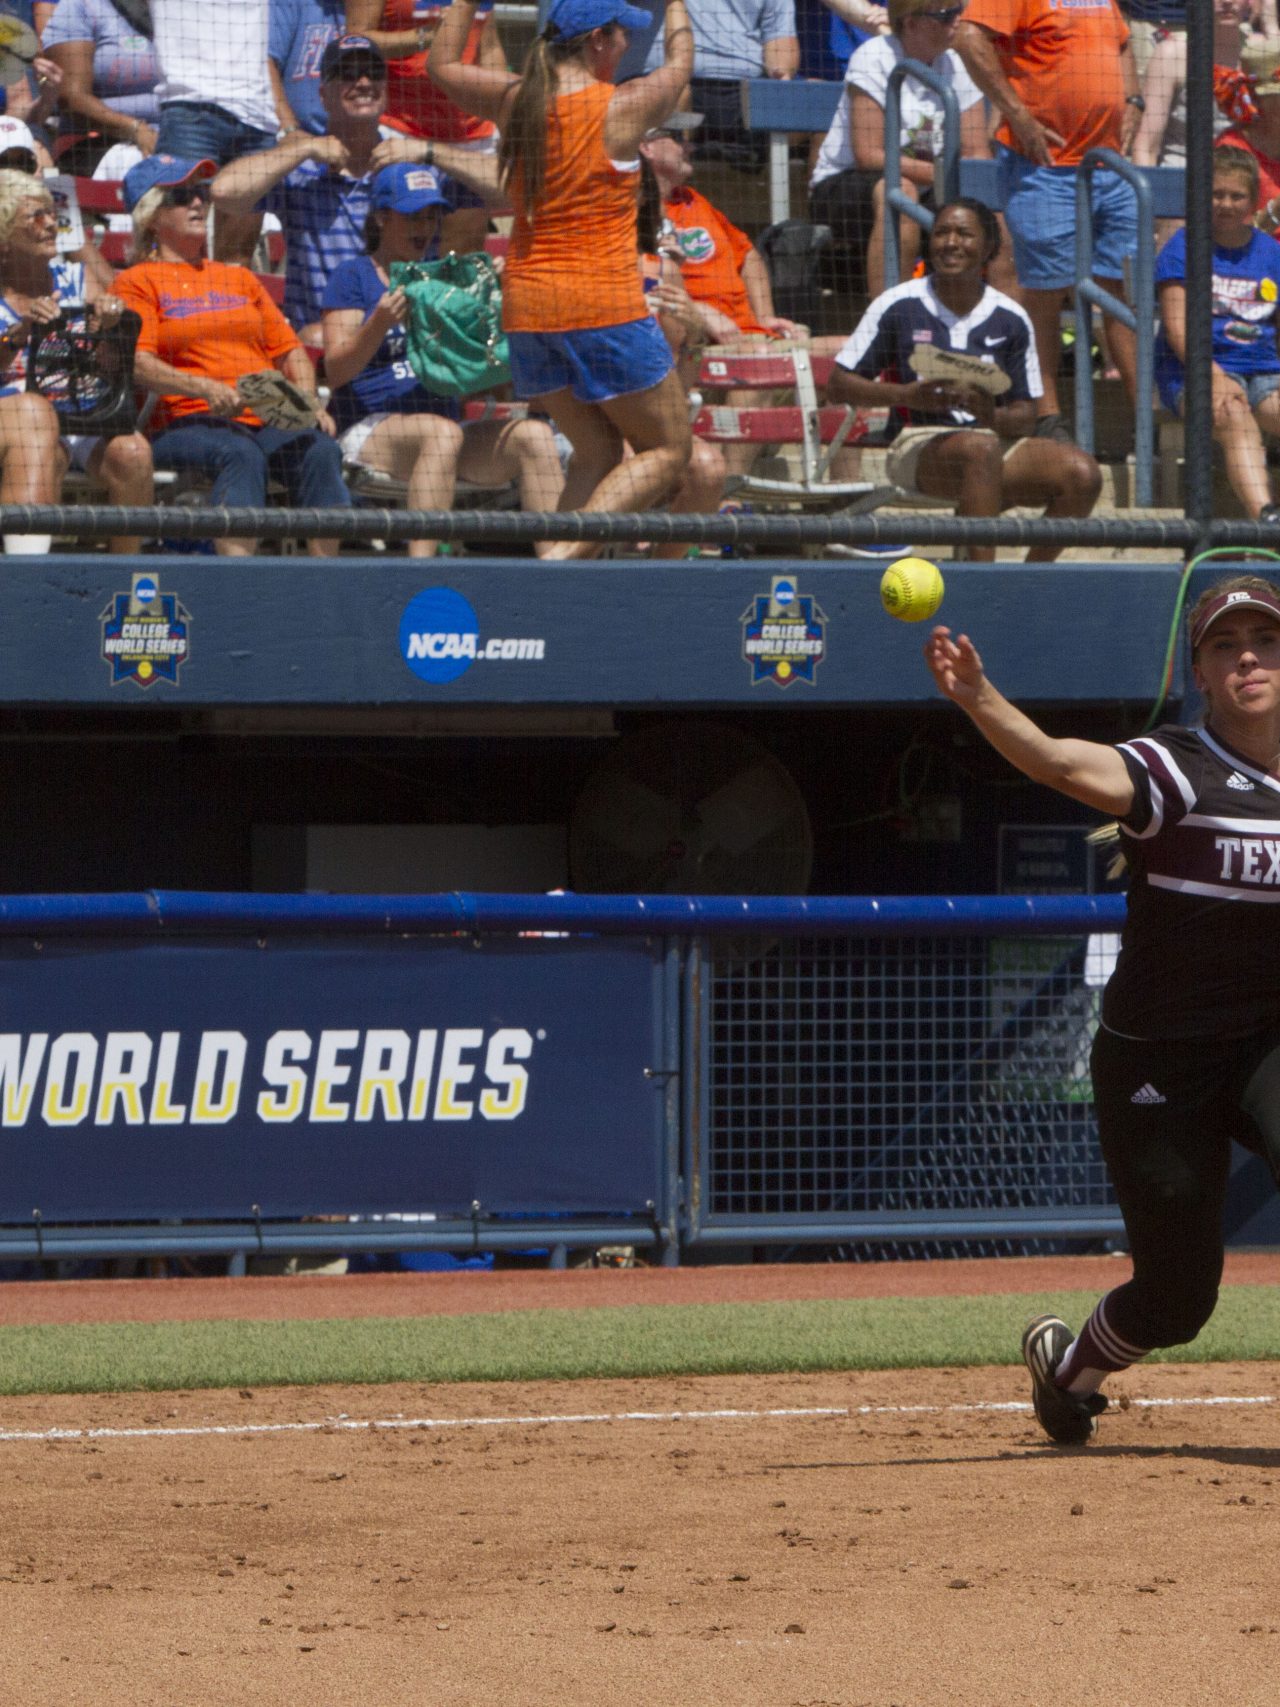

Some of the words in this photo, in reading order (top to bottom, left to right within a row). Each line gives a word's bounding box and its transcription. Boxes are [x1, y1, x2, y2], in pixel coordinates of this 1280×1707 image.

[122, 624, 170, 638] COLLEGE
[105, 639, 145, 654] WORLD
[145, 639, 186, 654] SERIES
[407, 633, 546, 660] NCAA.com
[257, 1029, 533, 1123] SERIES
[1131, 1095, 1167, 1104] adidas
